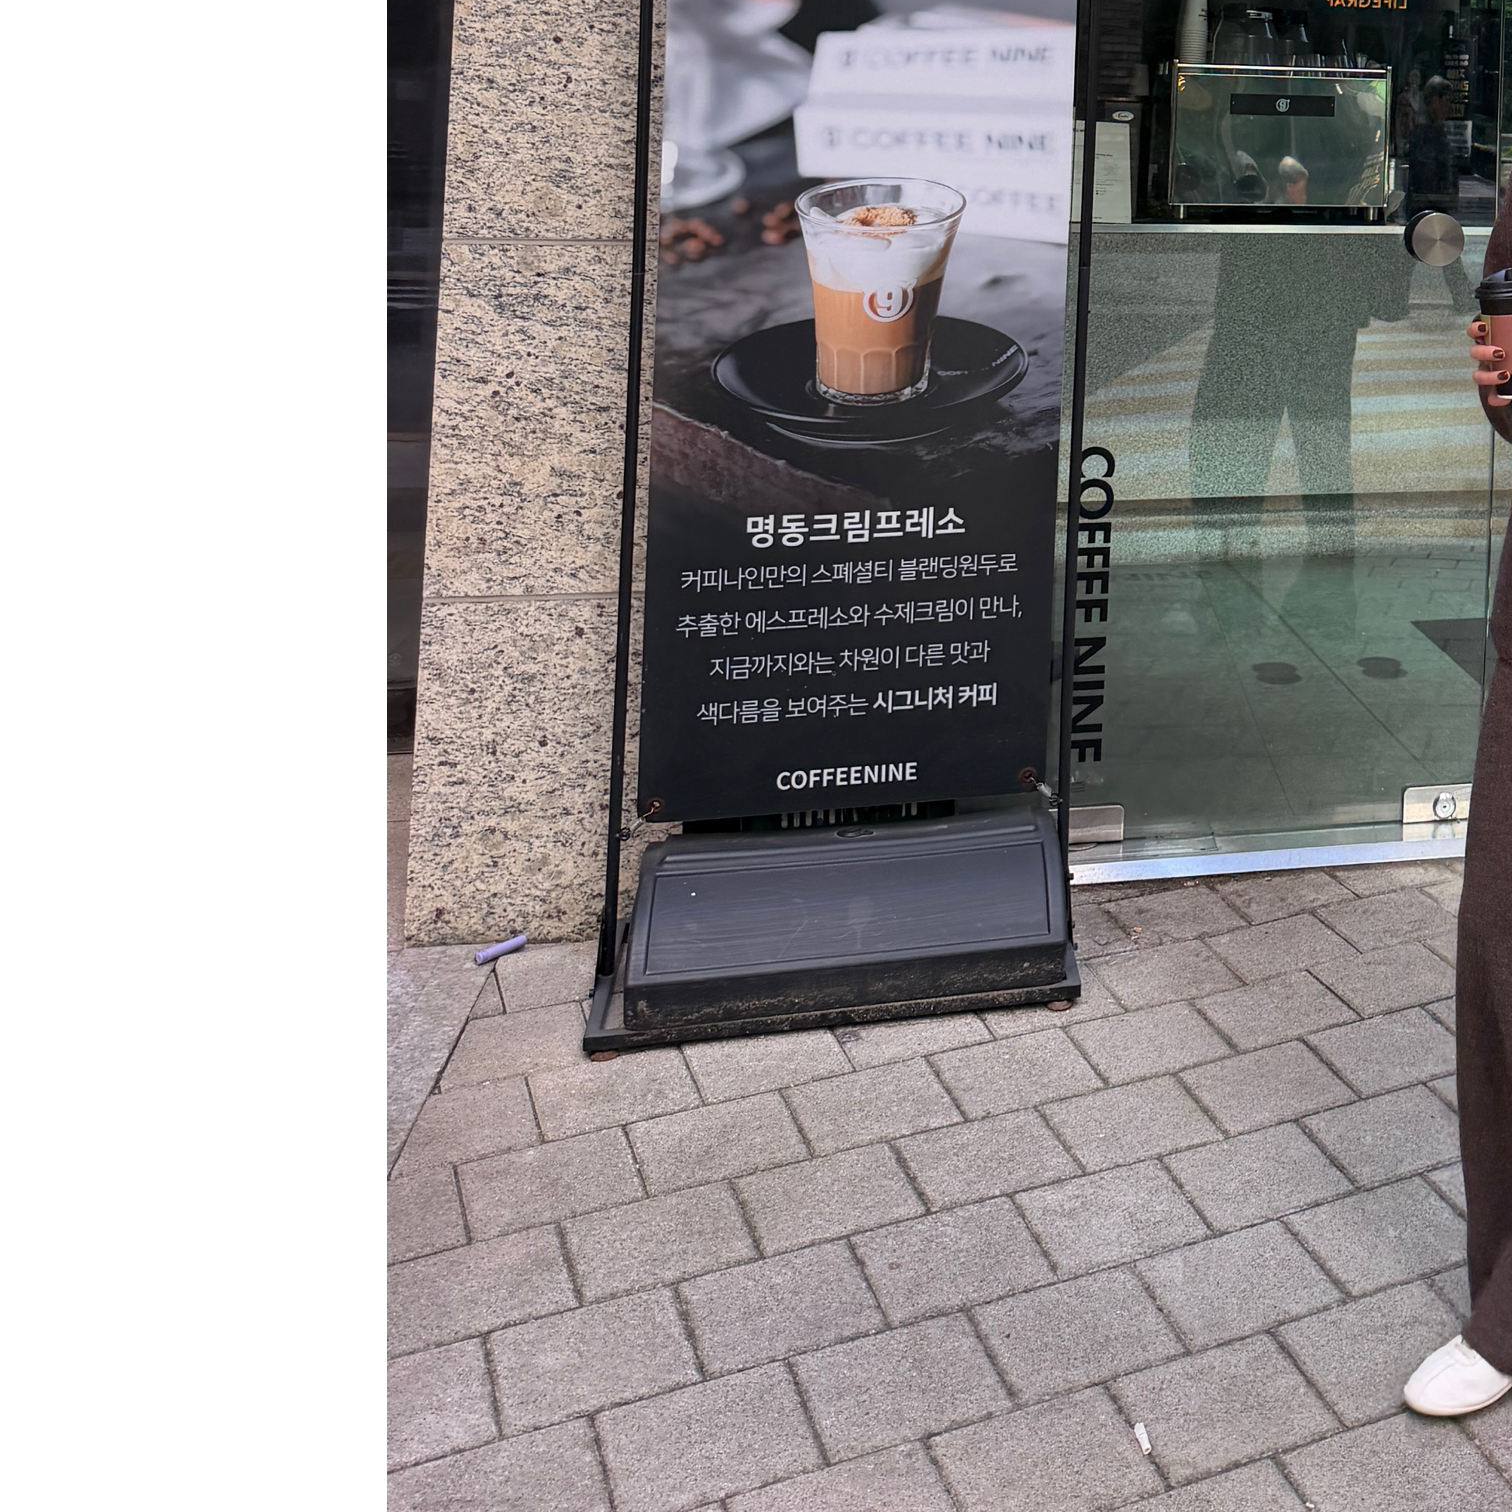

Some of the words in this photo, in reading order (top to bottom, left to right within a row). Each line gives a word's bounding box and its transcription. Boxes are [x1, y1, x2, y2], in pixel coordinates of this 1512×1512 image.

[746, 506, 966, 548] 명동크림프레소
[1077, 446, 1116, 623] COFFEE
[681, 563, 807, 593] 커피나인만의
[898, 553, 1018, 581] 블랜딩원두로
[676, 611, 742, 638] 추출한
[745, 604, 871, 633] 에스프레소와
[873, 597, 974, 626] 수제크림이
[979, 594, 1023, 619] 만나,
[709, 651, 836, 680] 지금까지와는
[839, 645, 900, 672] 차원이
[905, 642, 946, 667] 다른
[950, 639, 991, 664] 맛과
[697, 698, 783, 726] 색다름을
[785, 693, 869, 719] 보여주는
[873, 686, 953, 713] 시그니처
[958, 682, 998, 707] 커피
[1071, 636, 1107, 763] NINE
[776, 761, 919, 791] COFFEENINE
